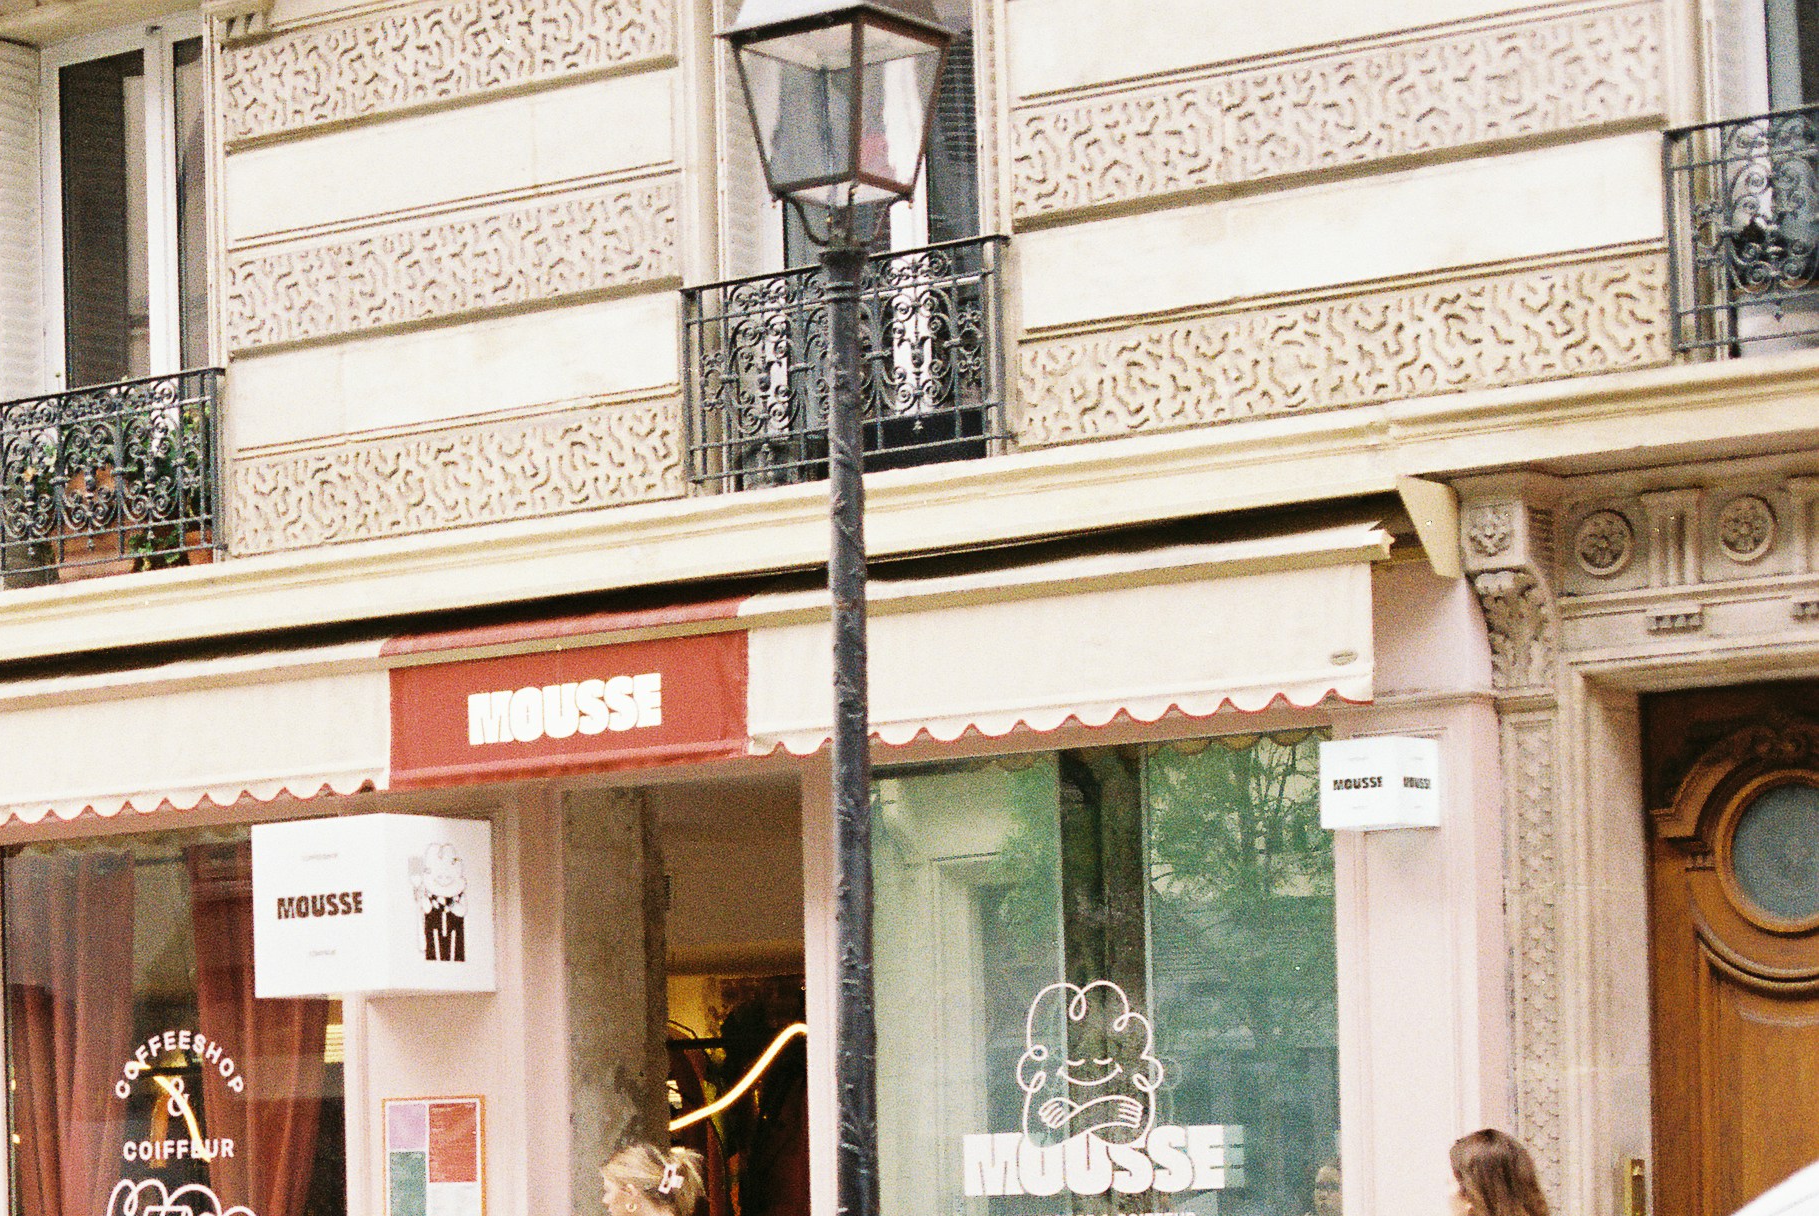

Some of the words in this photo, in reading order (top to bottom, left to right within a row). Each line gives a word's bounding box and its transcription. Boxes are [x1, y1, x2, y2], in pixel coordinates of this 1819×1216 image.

[468, 673, 662, 745] MOUSSE
[1333, 776, 1383, 790] MOUSSE
[277, 891, 363, 920] MOUSSE
[114, 1030, 244, 1100] COFFEESHOP
[167, 1077, 190, 1117] &
[123, 1138, 235, 1161] COIFFEUR
[963, 1125, 1226, 1197] MOUSSE
